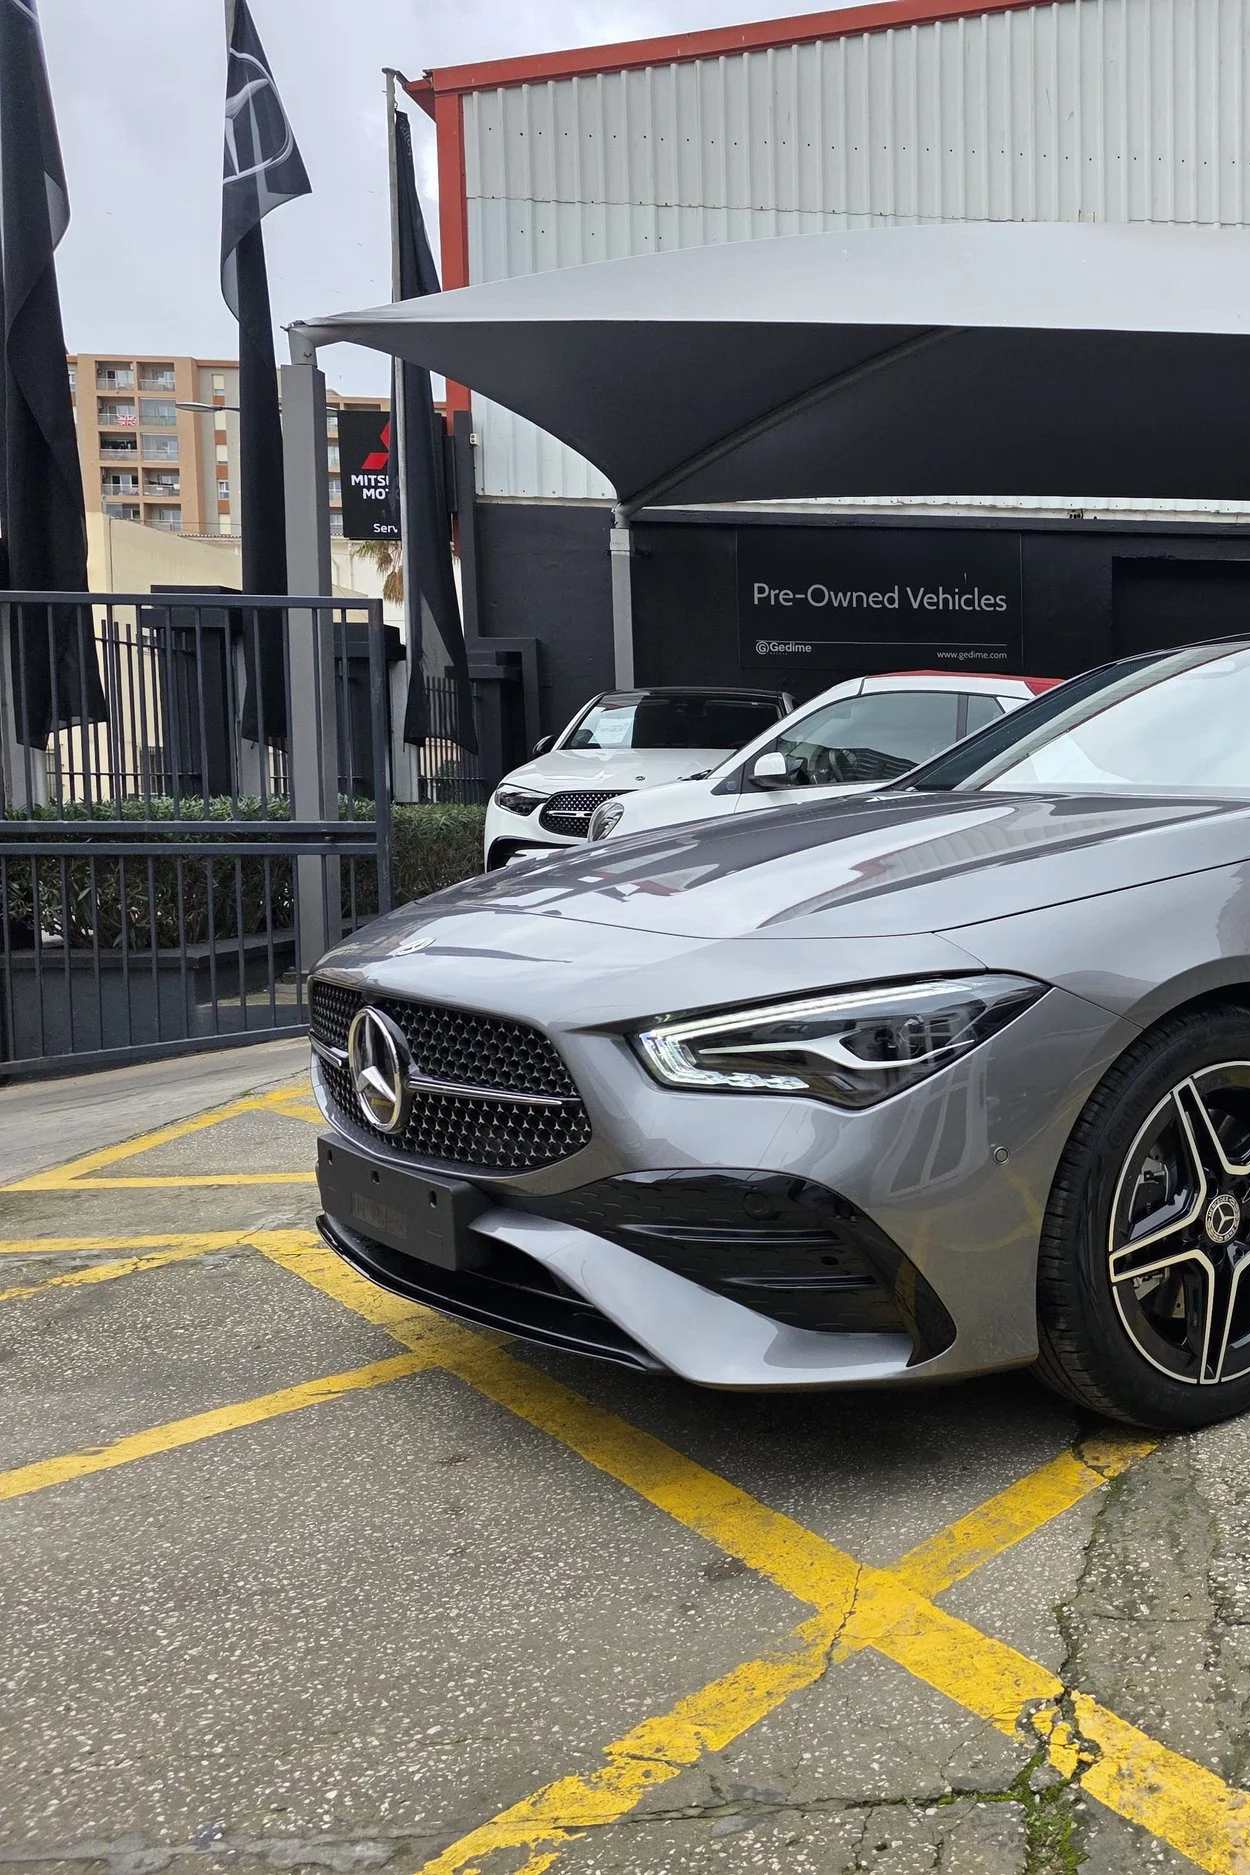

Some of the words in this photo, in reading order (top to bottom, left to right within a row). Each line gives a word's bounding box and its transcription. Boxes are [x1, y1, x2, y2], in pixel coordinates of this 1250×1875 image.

[351, 475, 389, 487] MITS
[753, 582, 899, 609] Pre-Owned
[907, 586, 1007, 611] Vehicles
[769, 641, 812, 653] Gedime
[936, 650, 1007, 661] www.gedime.com
